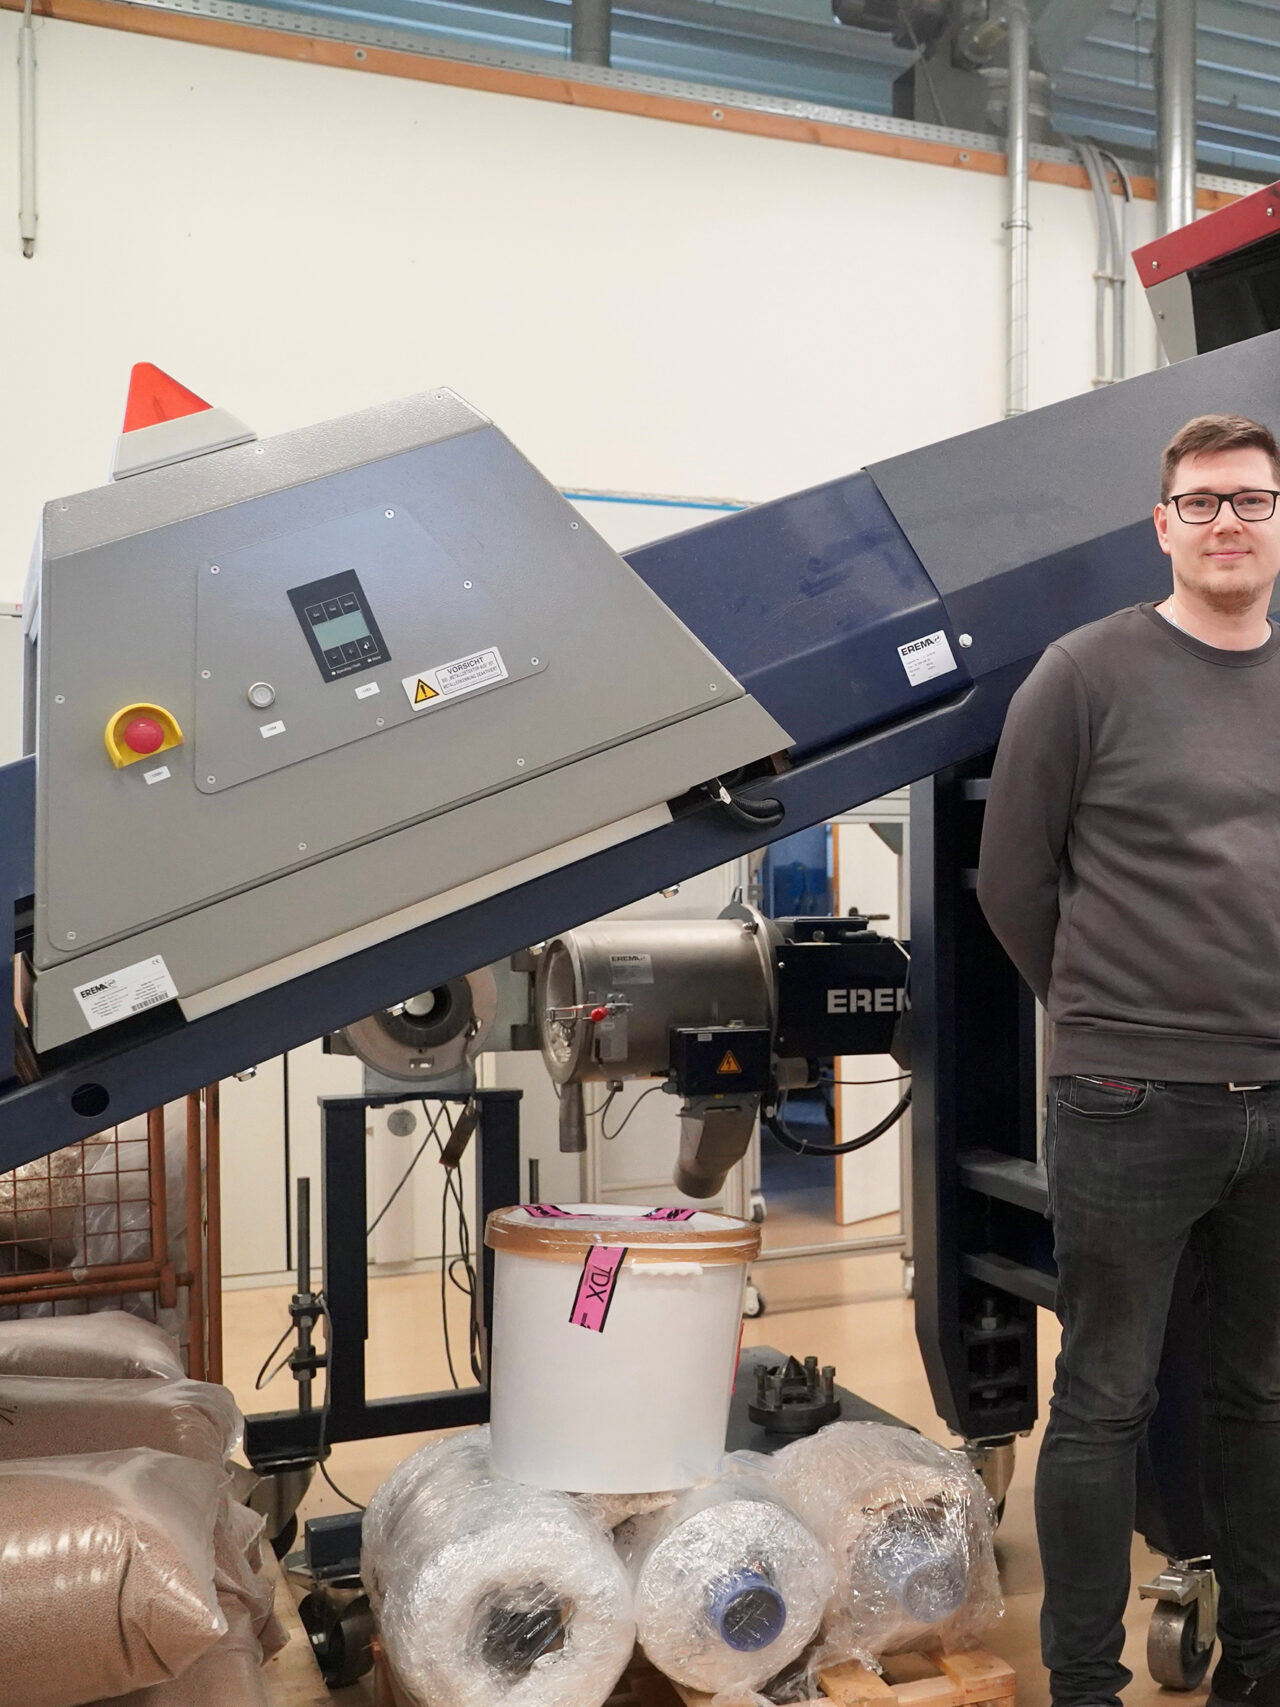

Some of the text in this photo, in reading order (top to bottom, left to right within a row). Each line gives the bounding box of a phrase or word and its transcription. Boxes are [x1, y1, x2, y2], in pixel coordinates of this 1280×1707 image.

[901, 638, 935, 656] EREMA
[447, 657, 484, 675] VORSICHT
[80, 983, 109, 999] EREMA
[827, 988, 912, 1013] EREM
[586, 1266, 613, 1303] TDX
